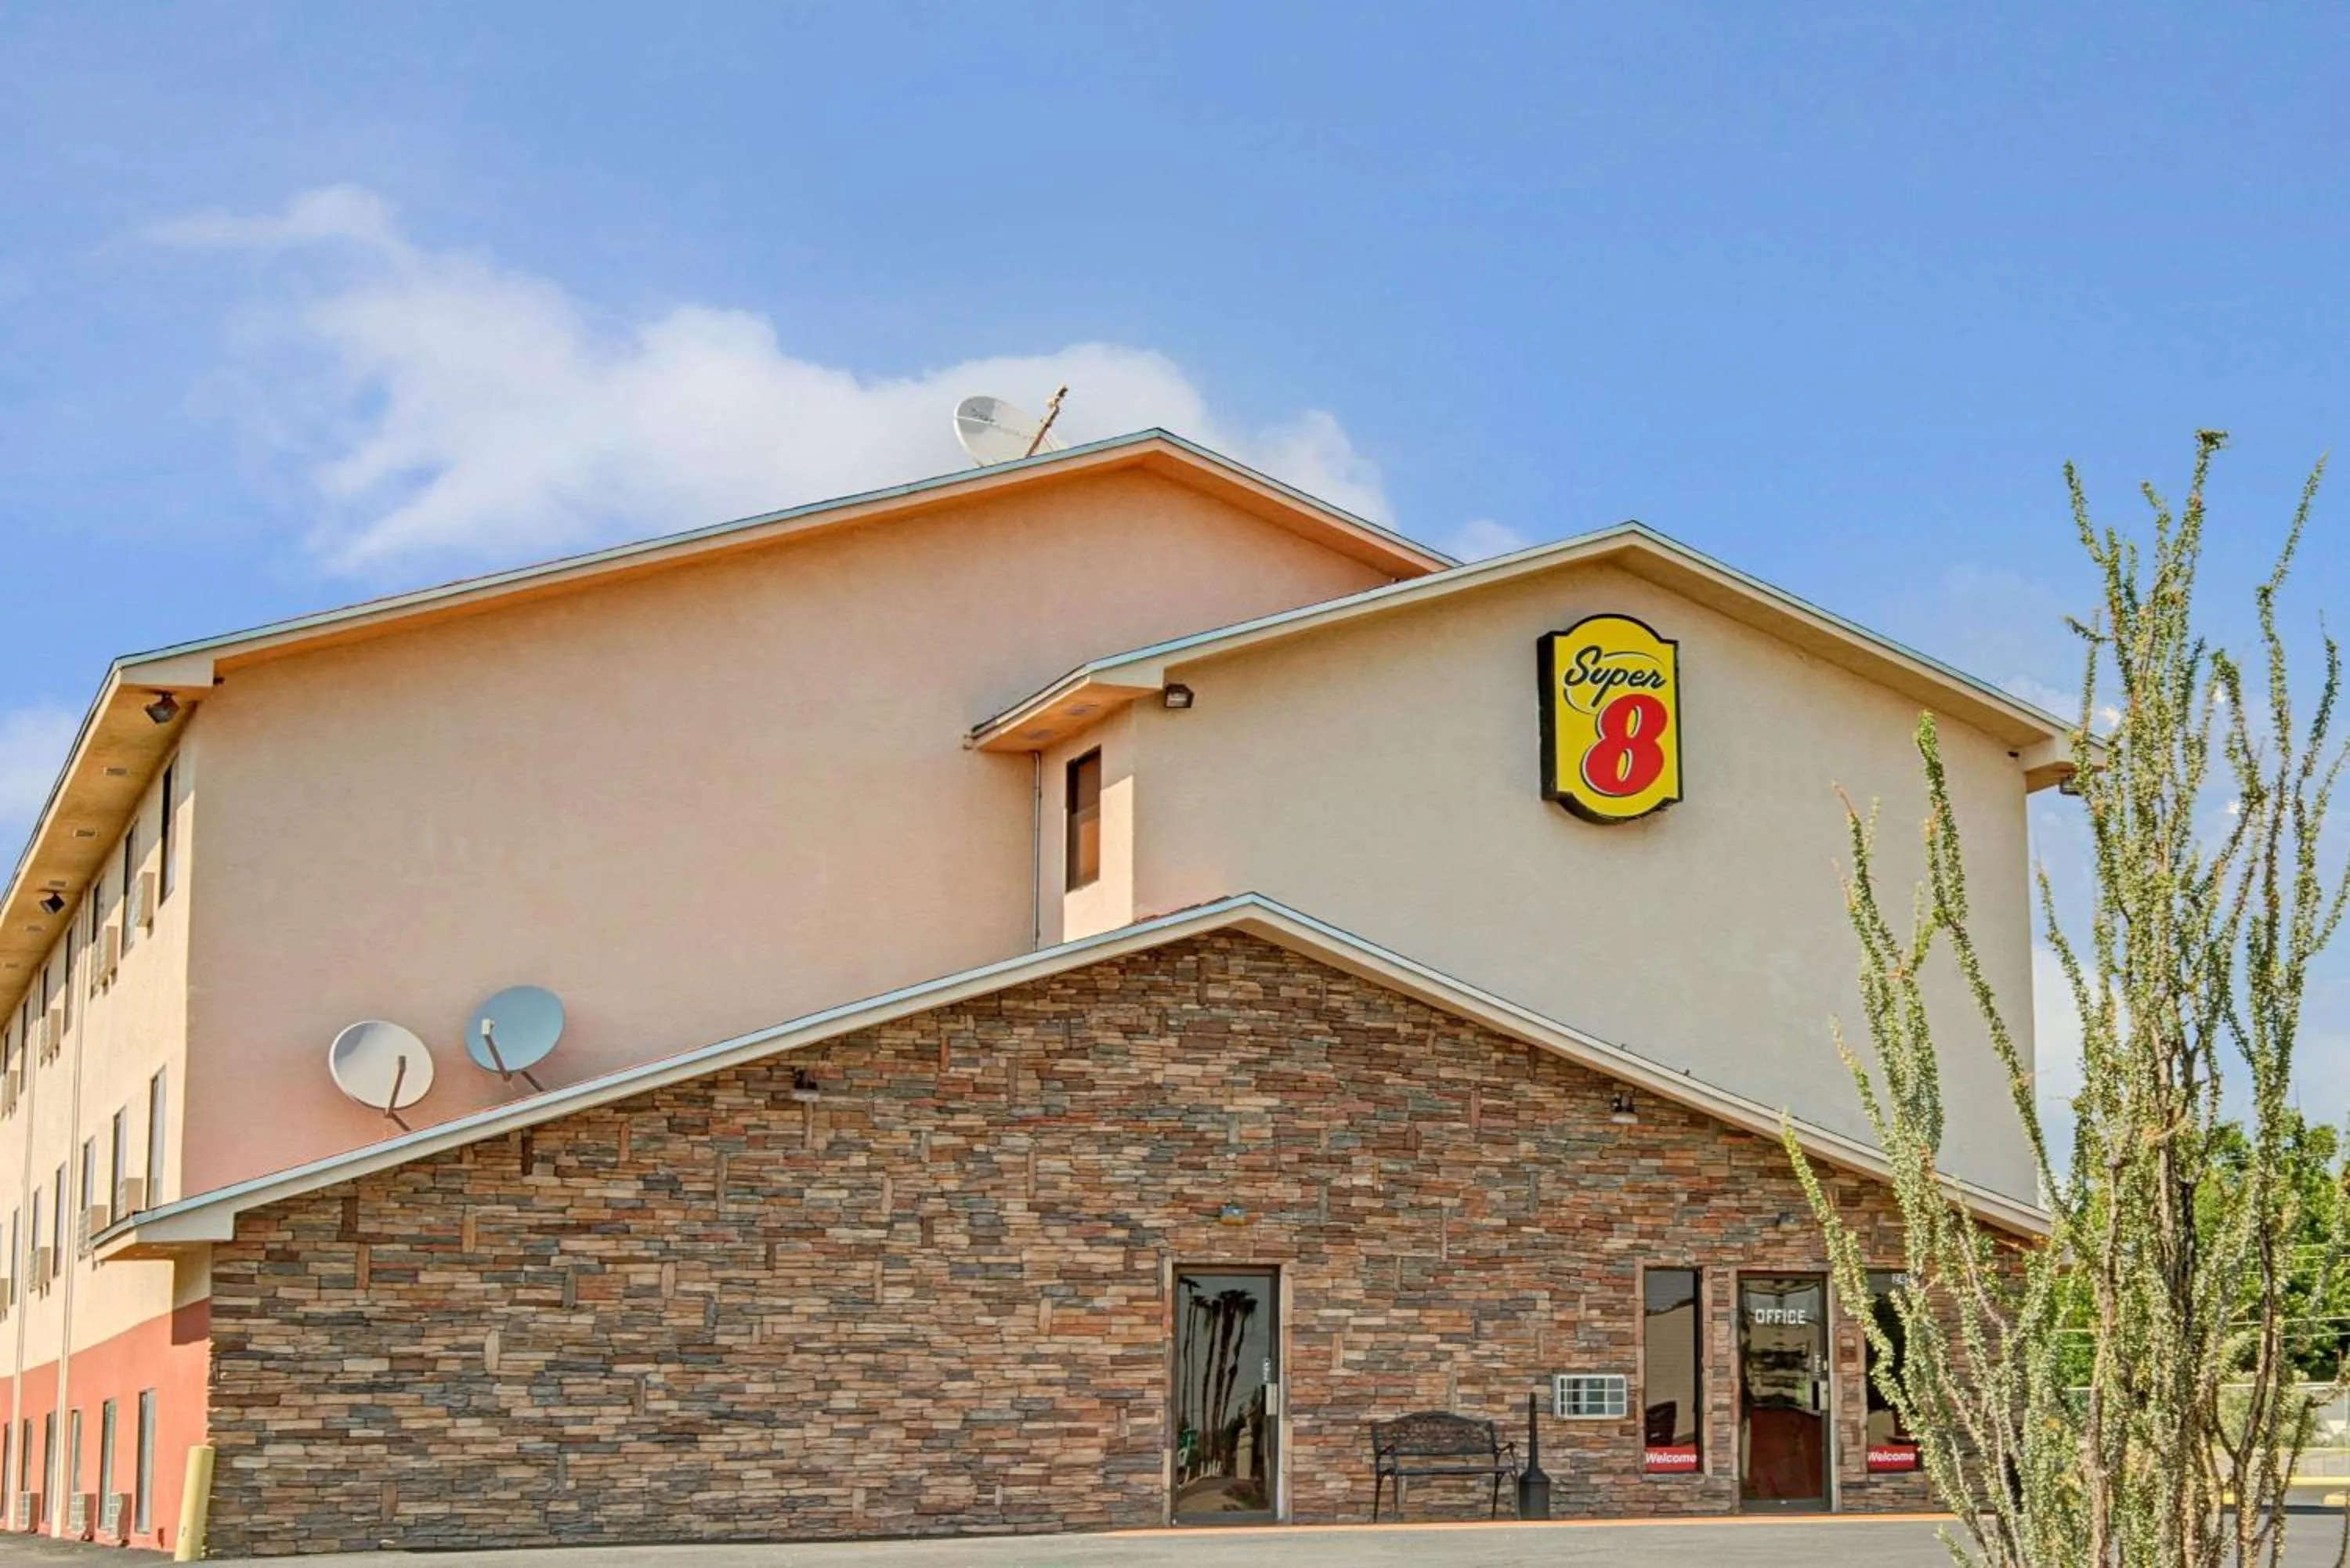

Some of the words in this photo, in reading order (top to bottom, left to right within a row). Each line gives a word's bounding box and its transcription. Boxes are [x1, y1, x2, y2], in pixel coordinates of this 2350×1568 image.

[1564, 645, 1667, 709] Super
[1580, 692, 1668, 797] 8
[1755, 1308, 1806, 1324] OFFICE
[1645, 1451, 1697, 1465] Welcome
[1867, 1451, 1915, 1463] Welcome
